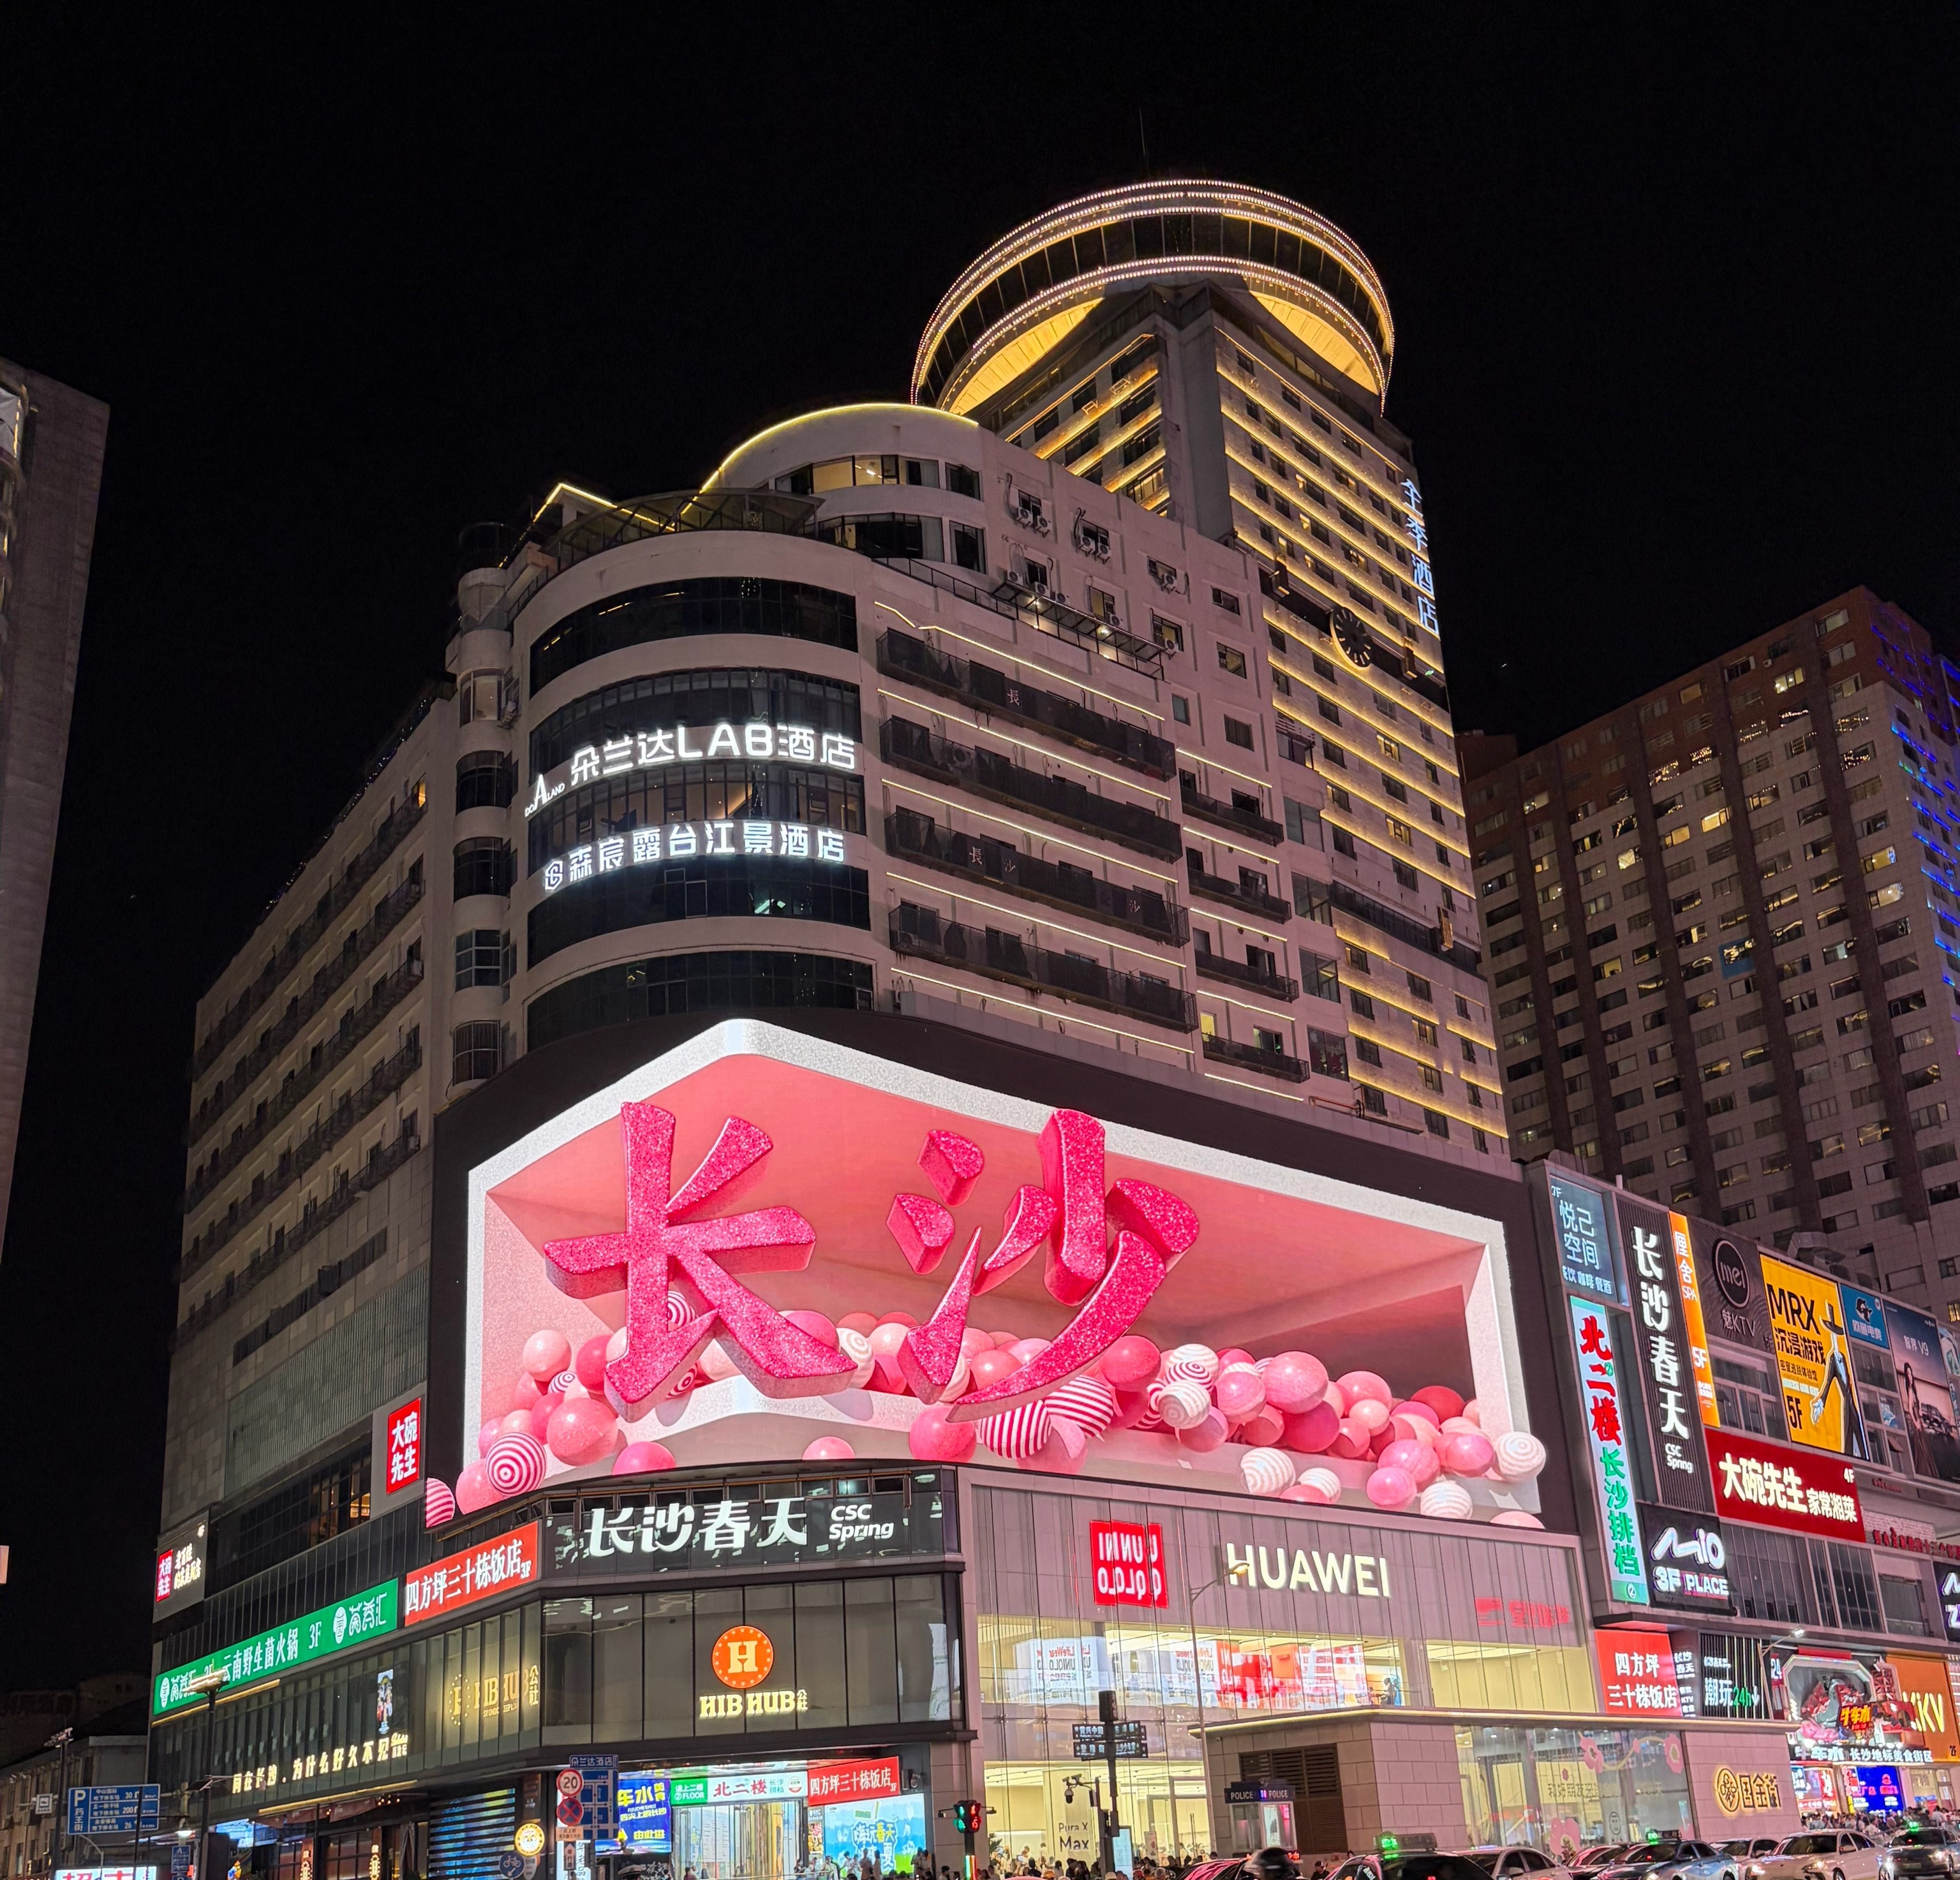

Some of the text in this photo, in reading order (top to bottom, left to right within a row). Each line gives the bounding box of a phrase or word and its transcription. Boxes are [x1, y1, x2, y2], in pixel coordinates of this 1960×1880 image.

[1401, 478, 1441, 637] 全季酒店
[571, 723, 855, 786] 朵兰达LAB酒店
[544, 1101, 1199, 1423] 长沙
[1564, 1232, 1600, 1271] 空间
[1766, 1283, 1821, 1335] MRX
[1632, 1225, 1689, 1440] 长沙春天
[1774, 1327, 1827, 1366] 沉浸游戏
[1691, 1346, 1709, 1369] 5F
[1918, 1340, 1929, 1356] V9
[1580, 1315, 1622, 1446] 北二楼
[1786, 1395, 1803, 1430] 5F
[391, 1410, 418, 1453] 大碗
[1665, 1442, 1682, 1458] CSC
[1667, 1455, 1694, 1474] Spring
[390, 1447, 417, 1484] 先生
[1718, 1452, 1808, 1513] 大碗先生
[831, 1503, 872, 1521] CSC
[1600, 1446, 1640, 1576] 长沙排档
[584, 1497, 807, 1557] 长沙春天
[829, 1521, 895, 1543] Spring
[405, 1538, 523, 1616] 四方坪三十栋饭店
[1226, 1543, 1391, 1597] HUAWEI
[1652, 1565, 1730, 1596] 3F PLACE
[308, 1620, 322, 1650] 3F
[1614, 1651, 1660, 1678] 四方坪
[1770, 1657, 1783, 1680] 24
[699, 1690, 796, 1718] HIB HUB
[1607, 1682, 1678, 1709] 三十栋饭店
[571, 1756, 613, 1767] 朵兰达酒店
[1850, 1747, 1933, 1763] 长沙地标美食街区
[563, 1776, 578, 1789] 20
[713, 1779, 768, 1798] 北二楼
[810, 1766, 891, 1797] 四方坪三十栋饭店
[1230, 1791, 1254, 1800] POLICE
[1268, 1789, 1289, 1798] POLICE
[74, 1789, 86, 1807] P
[1058, 1821, 1088, 1833] Pura X
[1059, 1835, 1089, 1853] Max
